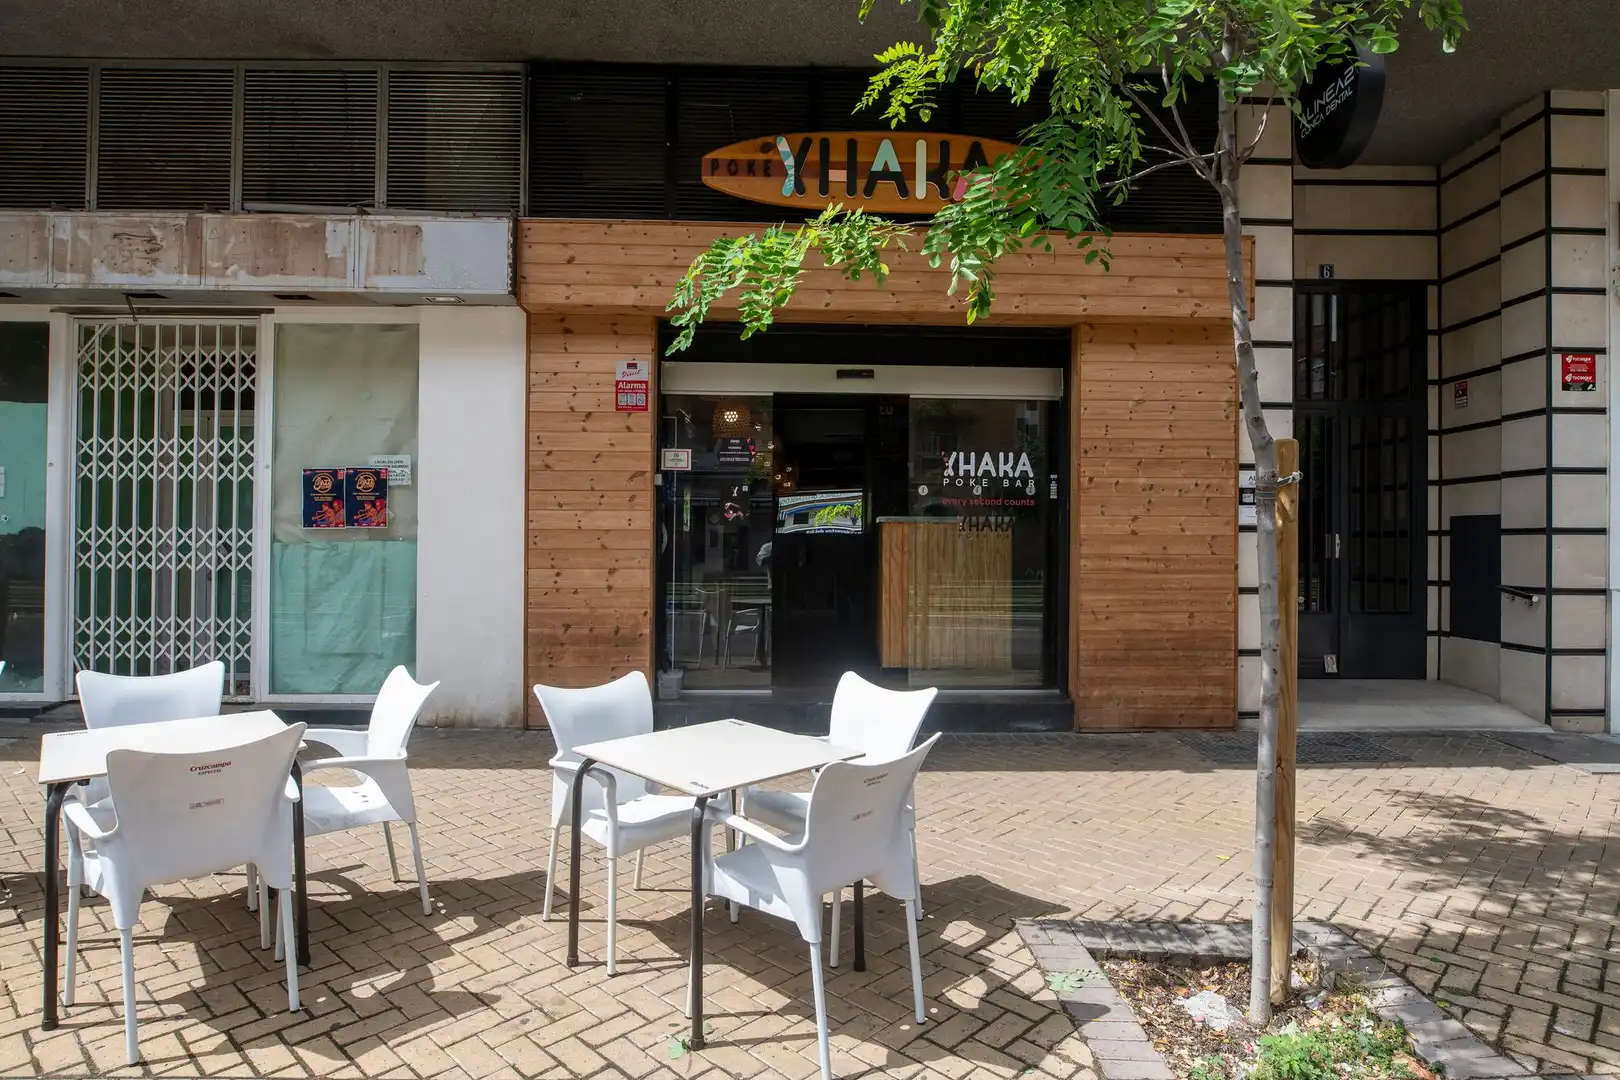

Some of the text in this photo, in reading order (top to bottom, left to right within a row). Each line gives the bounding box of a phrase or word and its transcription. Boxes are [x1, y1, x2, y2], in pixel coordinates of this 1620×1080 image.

[1325, 87, 1353, 116] DENTAL
[711, 158, 772, 177] POKE
[1323, 265, 1330, 279] 6
[618, 381, 646, 389] Alarma
[943, 478, 1035, 488] POKE BAR
[942, 498, 1035, 507] every second counts
[190, 761, 231, 771] Cruzcampo
